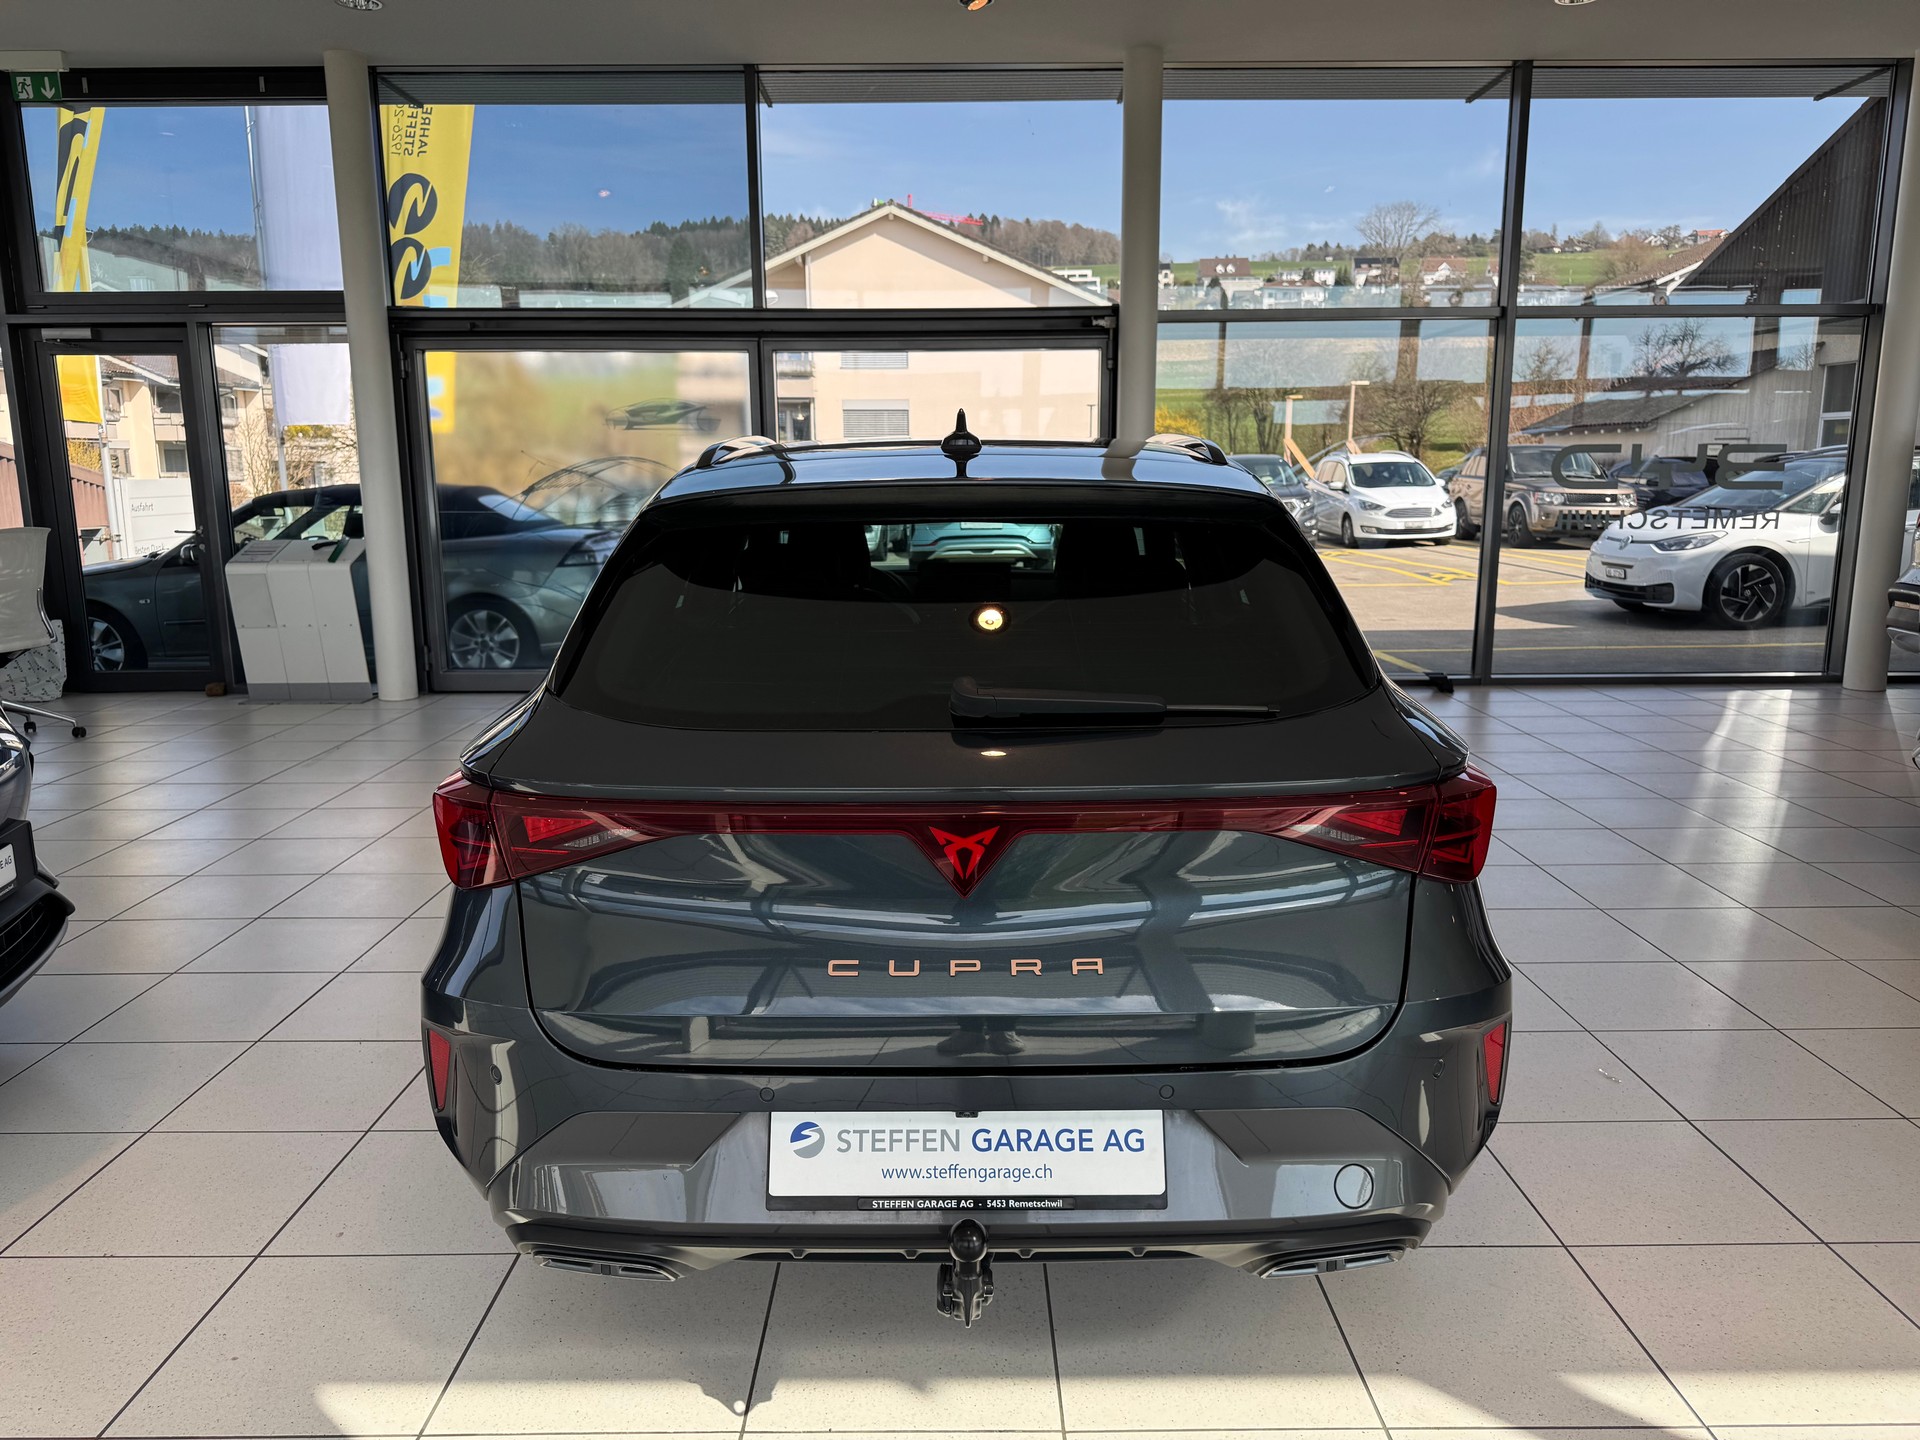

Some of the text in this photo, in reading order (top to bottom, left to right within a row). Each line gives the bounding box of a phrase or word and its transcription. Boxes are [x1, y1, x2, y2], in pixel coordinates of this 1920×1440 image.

[131, 502, 154, 512] Ausfahrt
[827, 957, 1105, 976] CUPRA
[836, 1128, 1145, 1153] STEFFEN GARAGE AG
[881, 1163, 1053, 1183] www.steffengarage.ch
[872, 1199, 915, 1209] STEFFEN
[916, 1199, 957, 1209] GARAGE
[959, 1199, 974, 1209] AG
[986, 1199, 1006, 1208] 5453
[1008, 1199, 1063, 1209] Remetschwil
